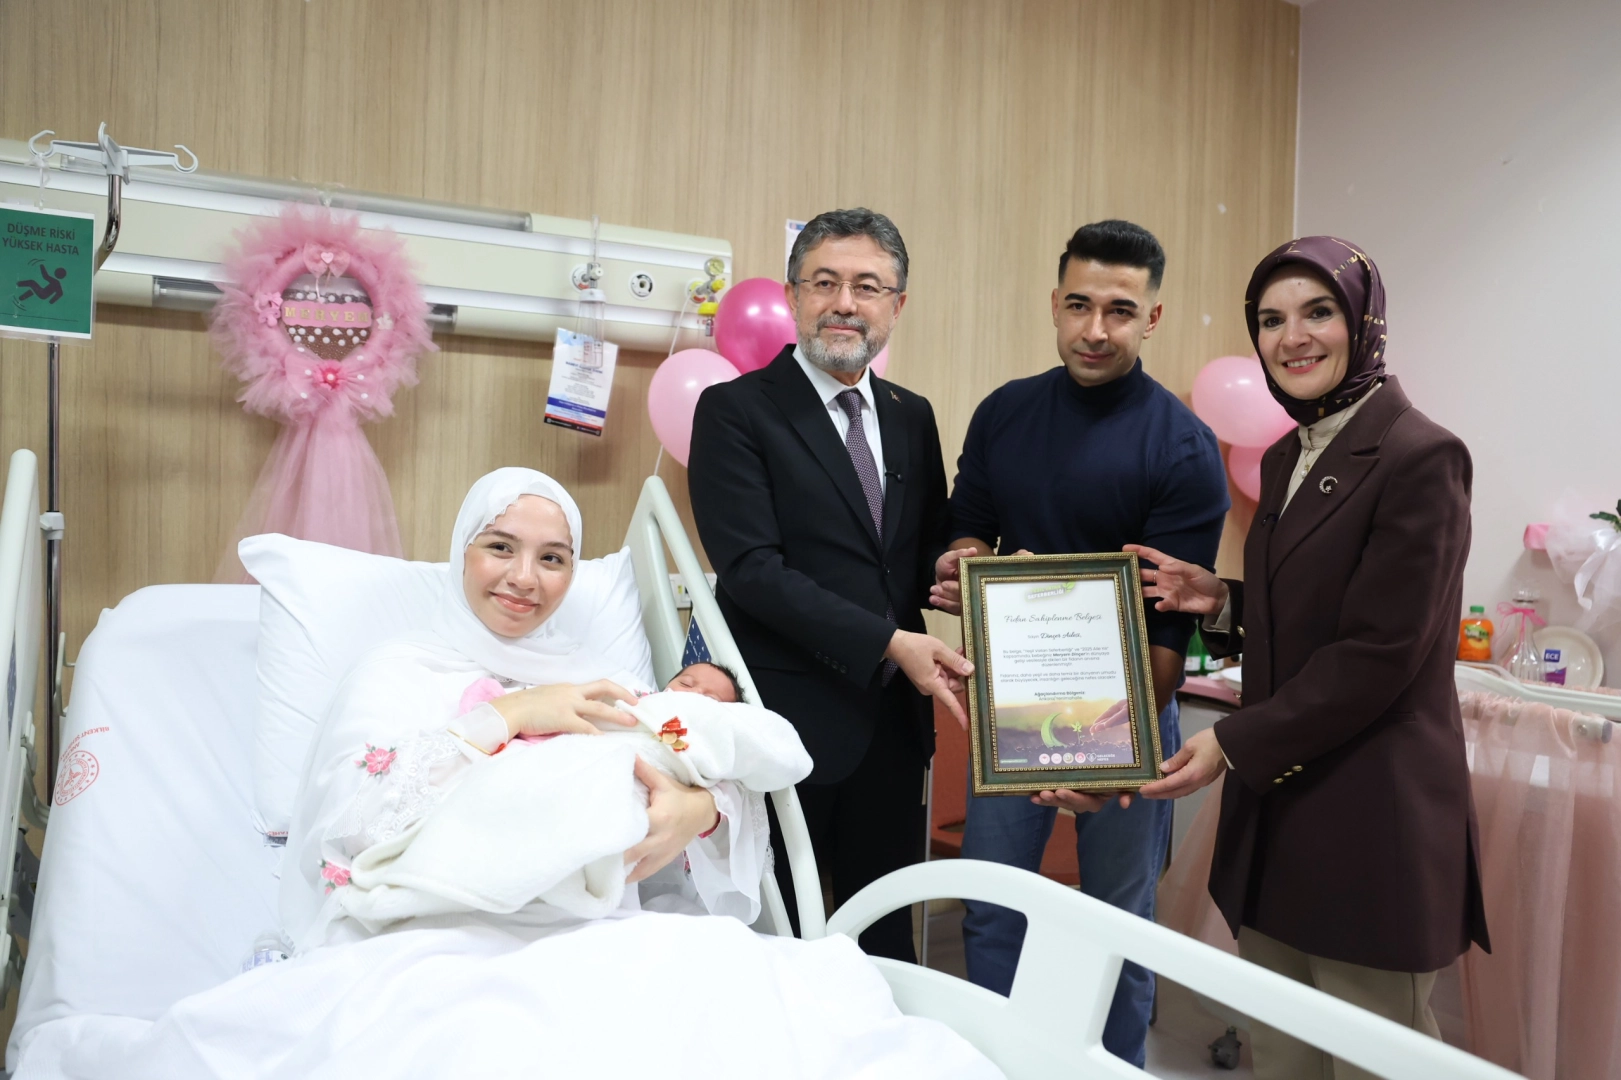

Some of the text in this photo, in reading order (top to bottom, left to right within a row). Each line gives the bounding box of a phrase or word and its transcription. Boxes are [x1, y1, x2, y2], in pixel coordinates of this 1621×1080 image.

[7, 222, 75, 240] DÜŞME RİSKİ
[2, 236, 79, 256] YÜKSEK HASTA
[284, 306, 369, 322] MERYEM
[1004, 612, 1102, 624] Fidan Sahiplenme Belgesi
[81, 726, 110, 738] BİLKENT
